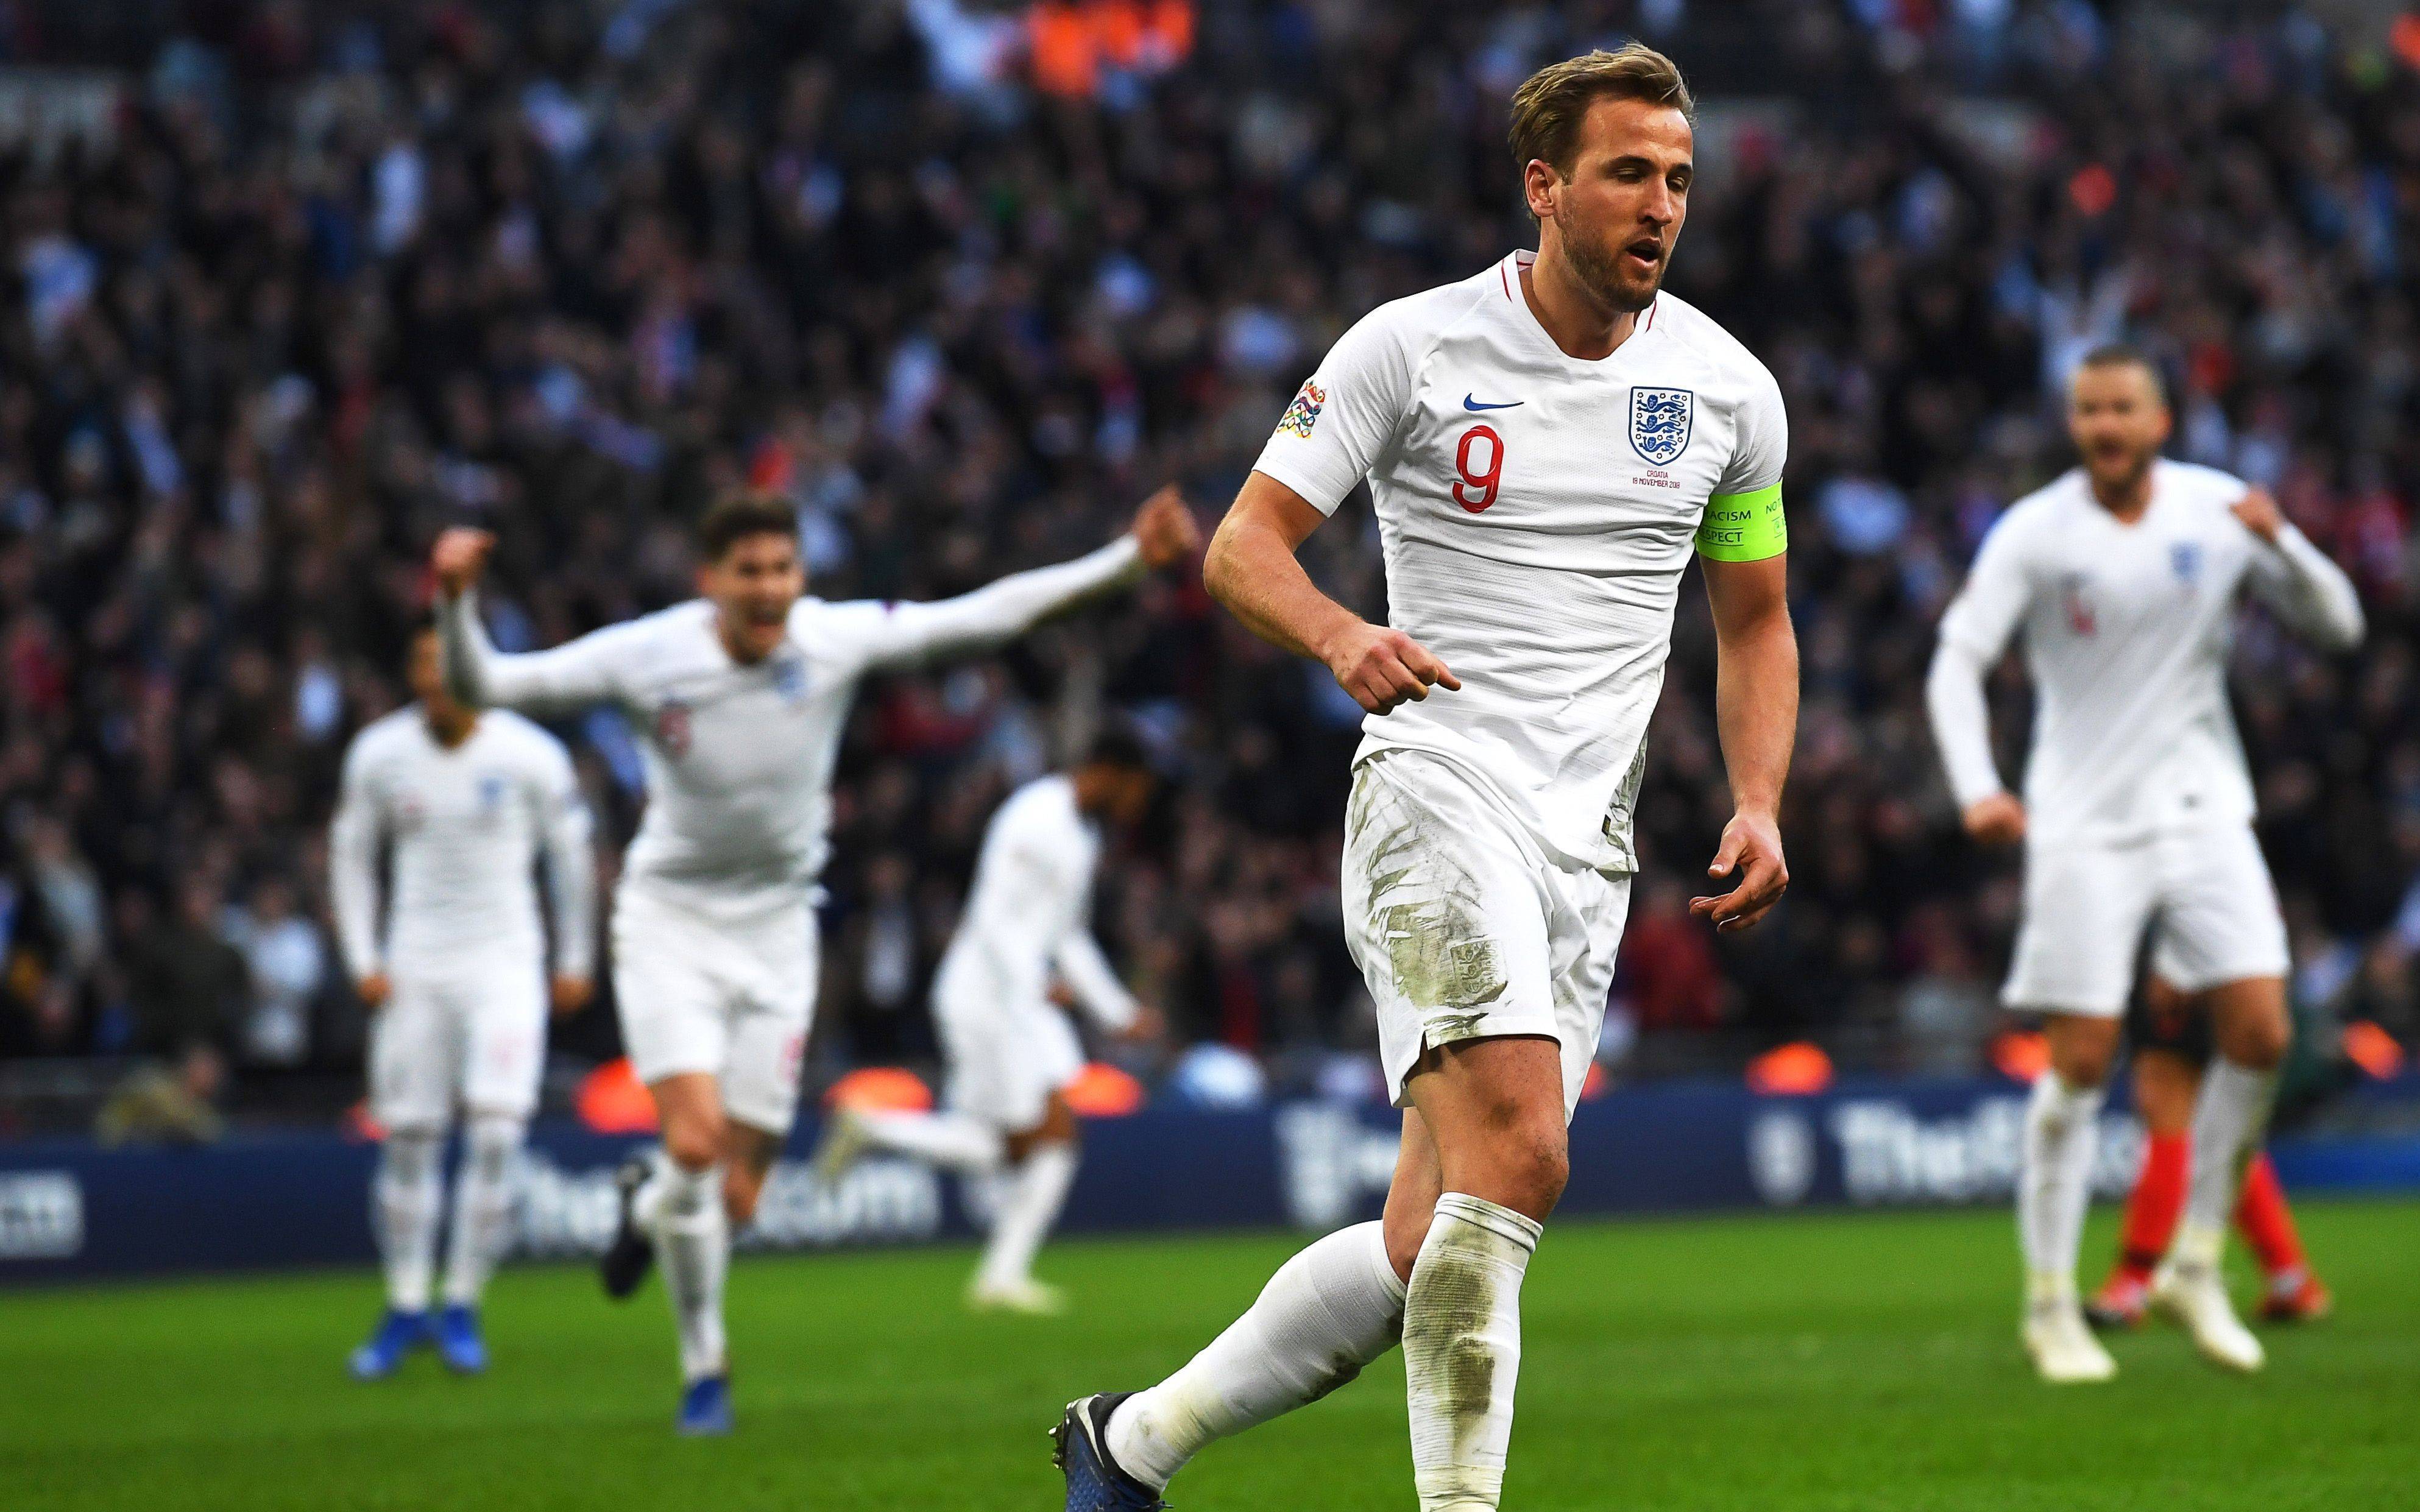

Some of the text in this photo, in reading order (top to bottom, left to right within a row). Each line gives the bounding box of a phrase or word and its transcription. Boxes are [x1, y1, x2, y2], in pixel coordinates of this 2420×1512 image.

[1452, 425, 1504, 514] 9
[1647, 470, 1668, 479] CROATIA
[1639, 478, 1668, 487] NOVEMBER
[1766, 501, 1777, 514] NO
